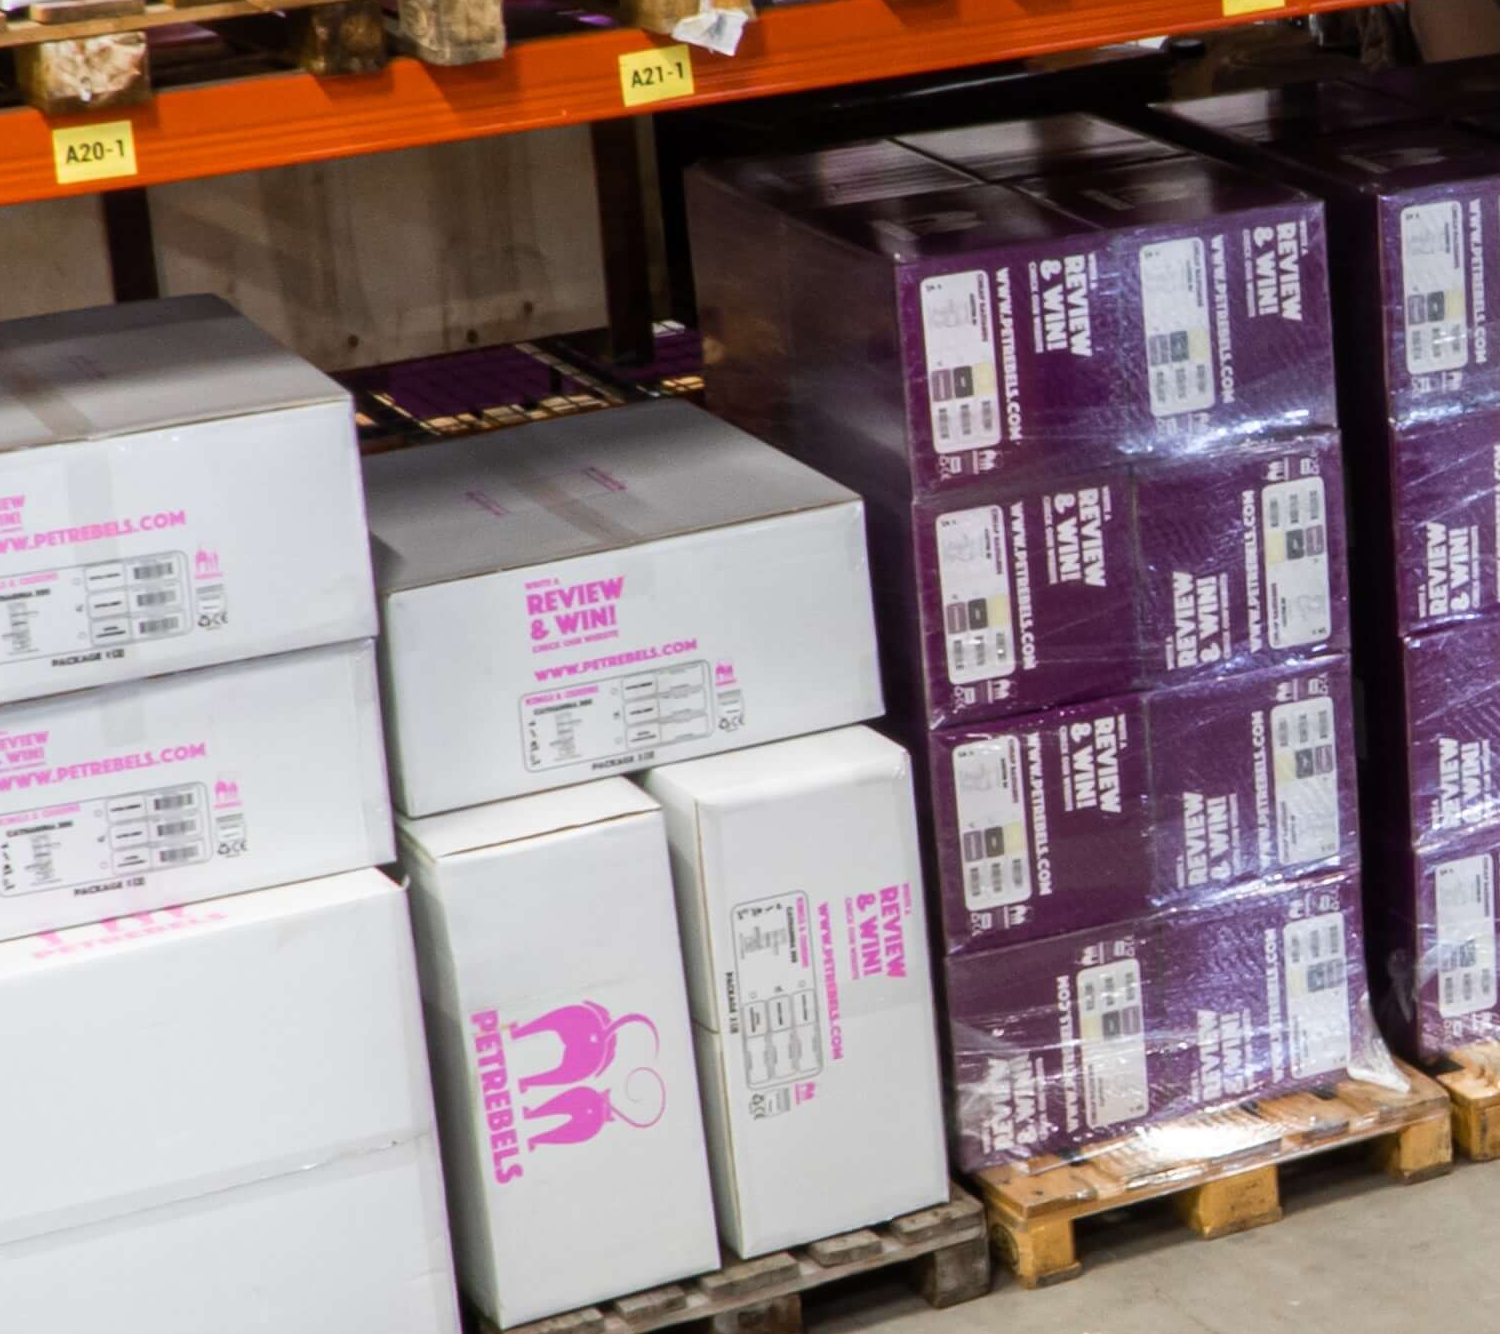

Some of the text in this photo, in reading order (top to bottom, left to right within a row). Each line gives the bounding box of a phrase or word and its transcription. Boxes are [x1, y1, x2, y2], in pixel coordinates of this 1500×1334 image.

[631, 62, 686, 89] A21-1
[66, 139, 125, 164] A20-1
[1256, 251, 1278, 315] WIN!
[1276, 222, 1302, 320] REVIEW
[1043, 284, 1067, 350] WIN!
[1064, 255, 1092, 356] REVIEW
[1057, 517, 1081, 581] WIN!
[1078, 488, 1106, 586] REVIEW
[526, 577, 623, 615] REVIEW
[531, 604, 615, 640] & WIN!
[534, 638, 698, 682] WWW.PETREBELS.COM
[5, 747, 42, 765] WIN!
[855, 893, 881, 975] & WIN!
[880, 886, 906, 977] REVIEW
[818, 902, 842, 1059] WWW.PETREBELS.COM
[471, 1009, 523, 1184] PETREBELS
